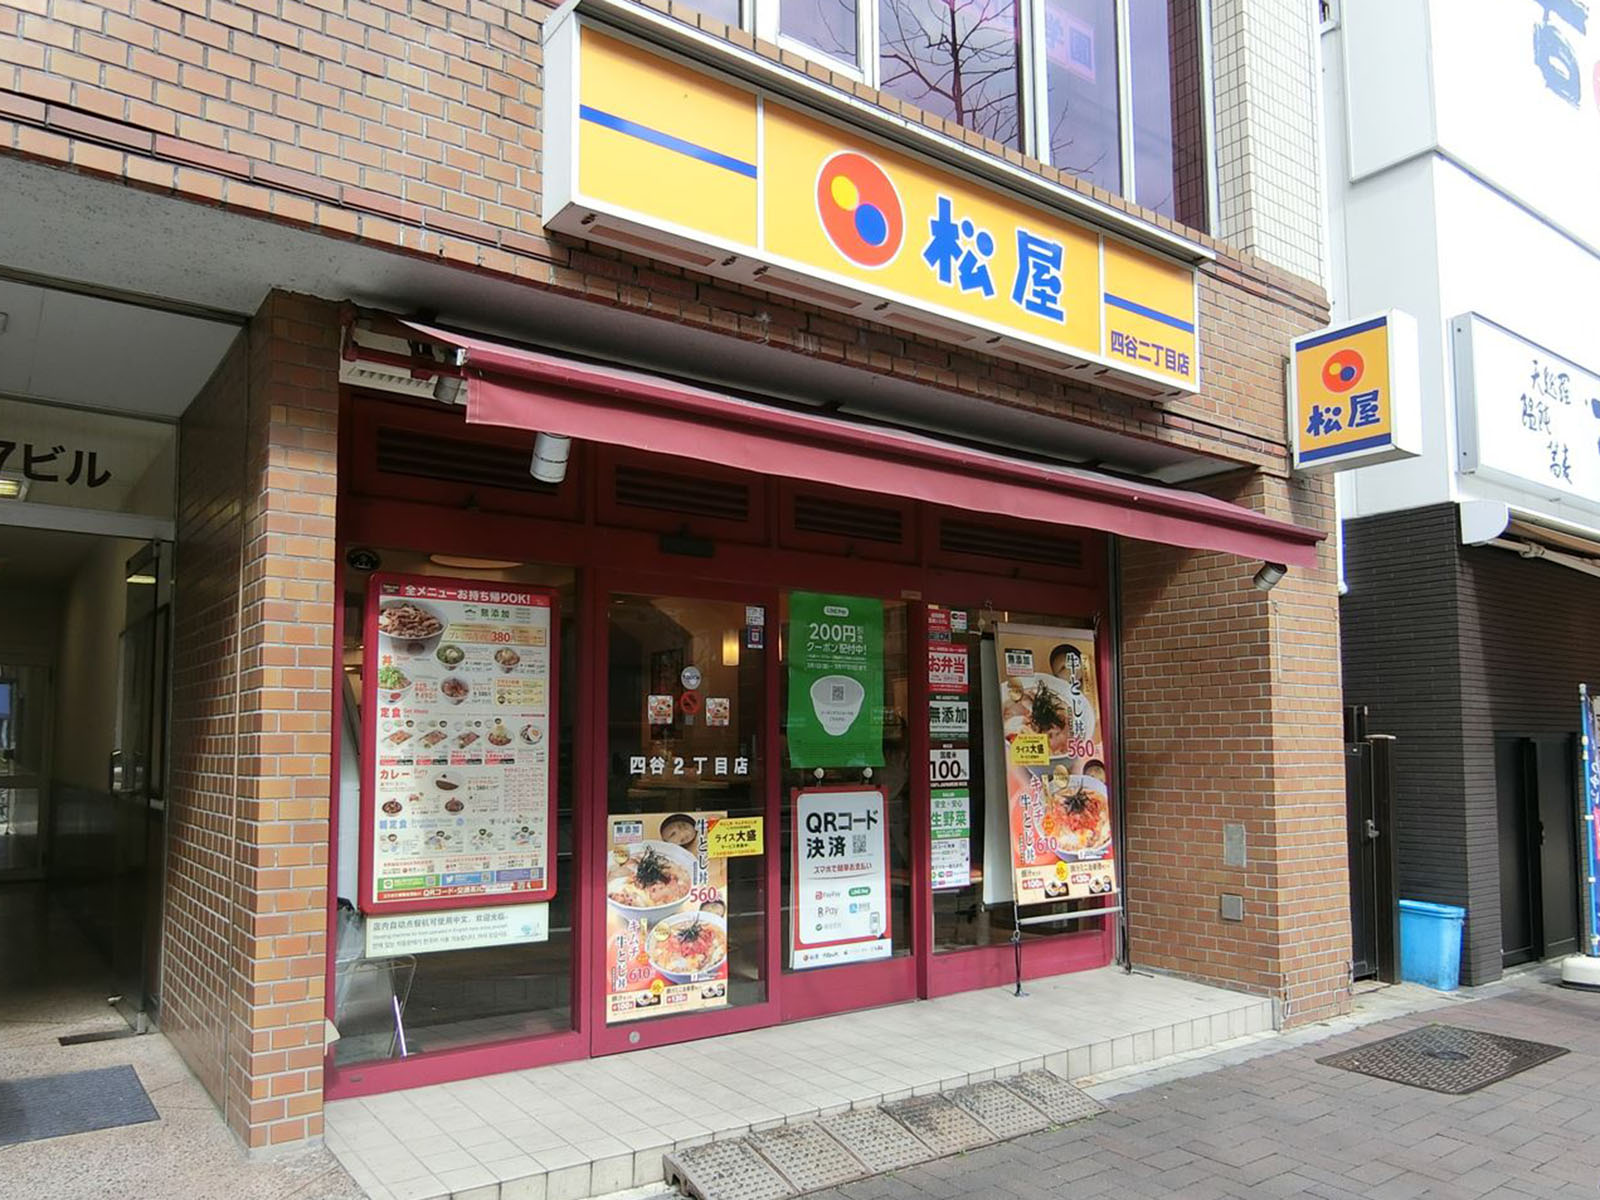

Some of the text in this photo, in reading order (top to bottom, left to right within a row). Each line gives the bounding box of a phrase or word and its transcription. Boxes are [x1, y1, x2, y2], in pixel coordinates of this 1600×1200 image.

[922, 196, 1065, 324] 松屋
[1110, 330, 1190, 377] 四谷二丁目店
[1306, 389, 1381, 437] 松屋
[809, 622, 857, 643] 200円
[929, 655, 965, 675] お弁当
[929, 706, 968, 724] 無添加
[379, 768, 411, 780] カレー
[806, 809, 879, 834] QRコード
[931, 810, 967, 828] 生野菜
[715, 829, 757, 844] ライス大盛
[806, 836, 846, 859] 決済
